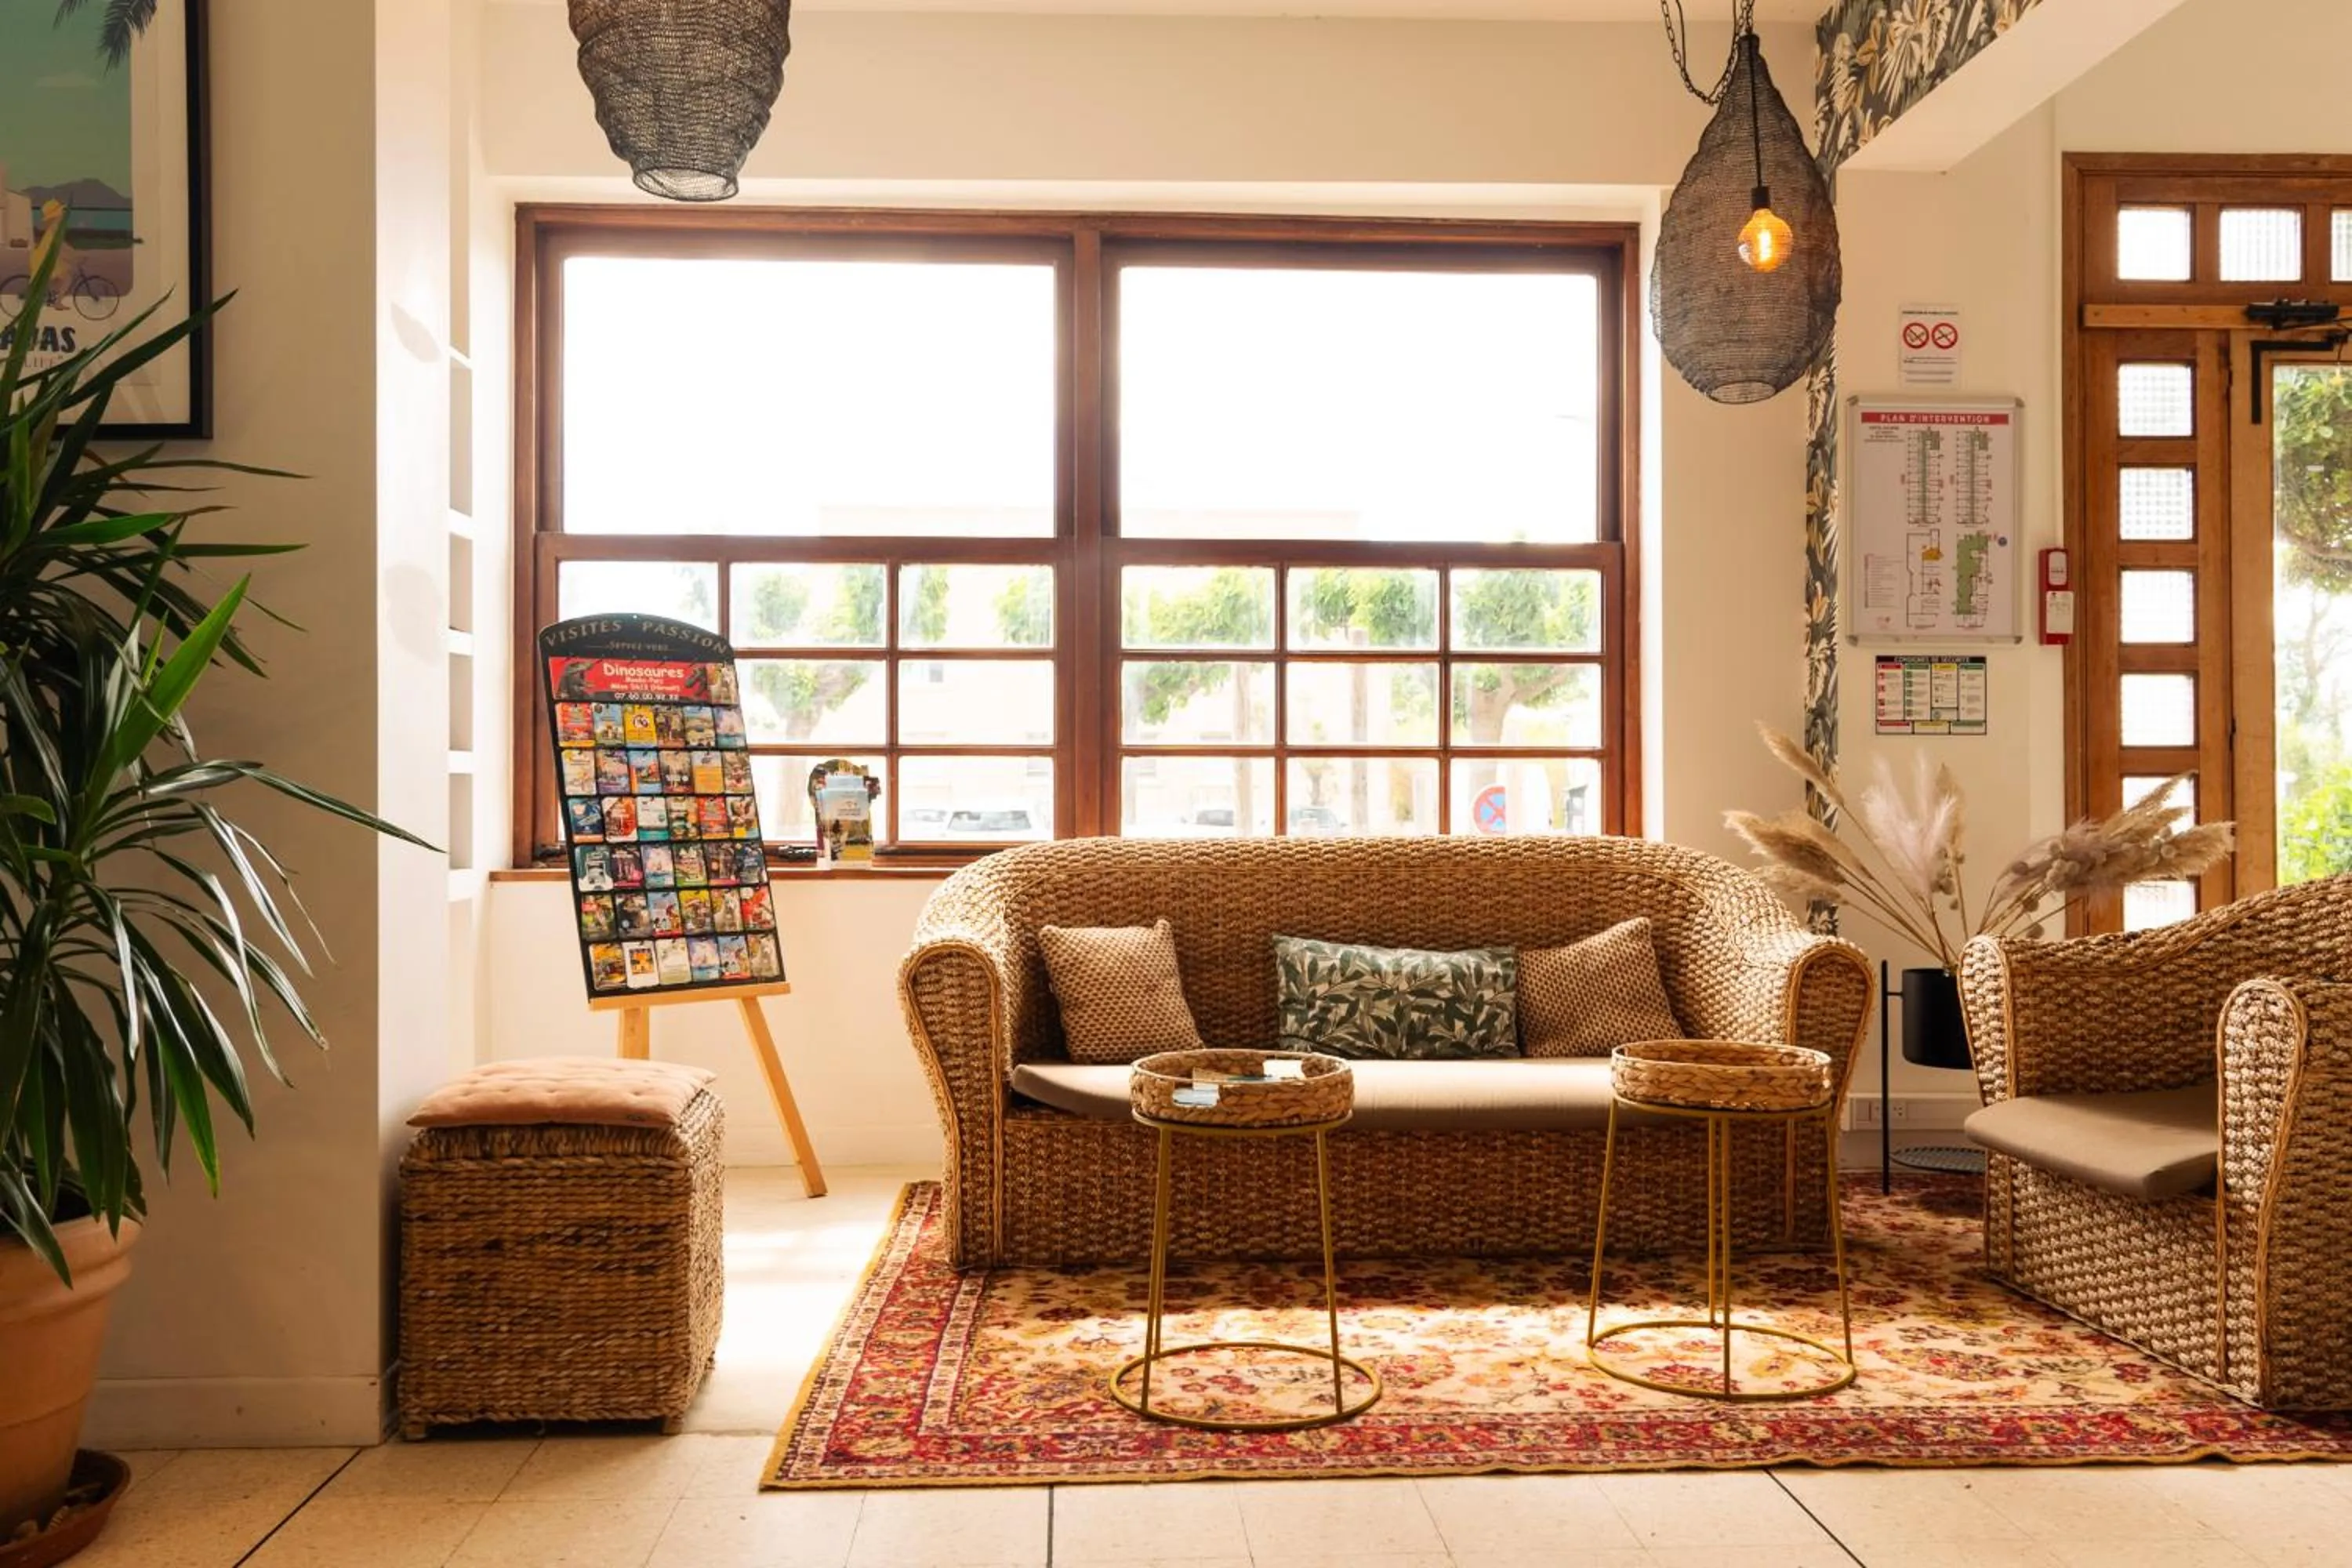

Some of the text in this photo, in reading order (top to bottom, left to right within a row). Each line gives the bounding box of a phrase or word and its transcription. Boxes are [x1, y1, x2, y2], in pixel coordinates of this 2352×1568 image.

[1881, 414, 1991, 423] PLAN D'INTERVENTION
[546, 620, 728, 655] VISITES PASSION
[603, 662, 684, 678] Dinosaures
